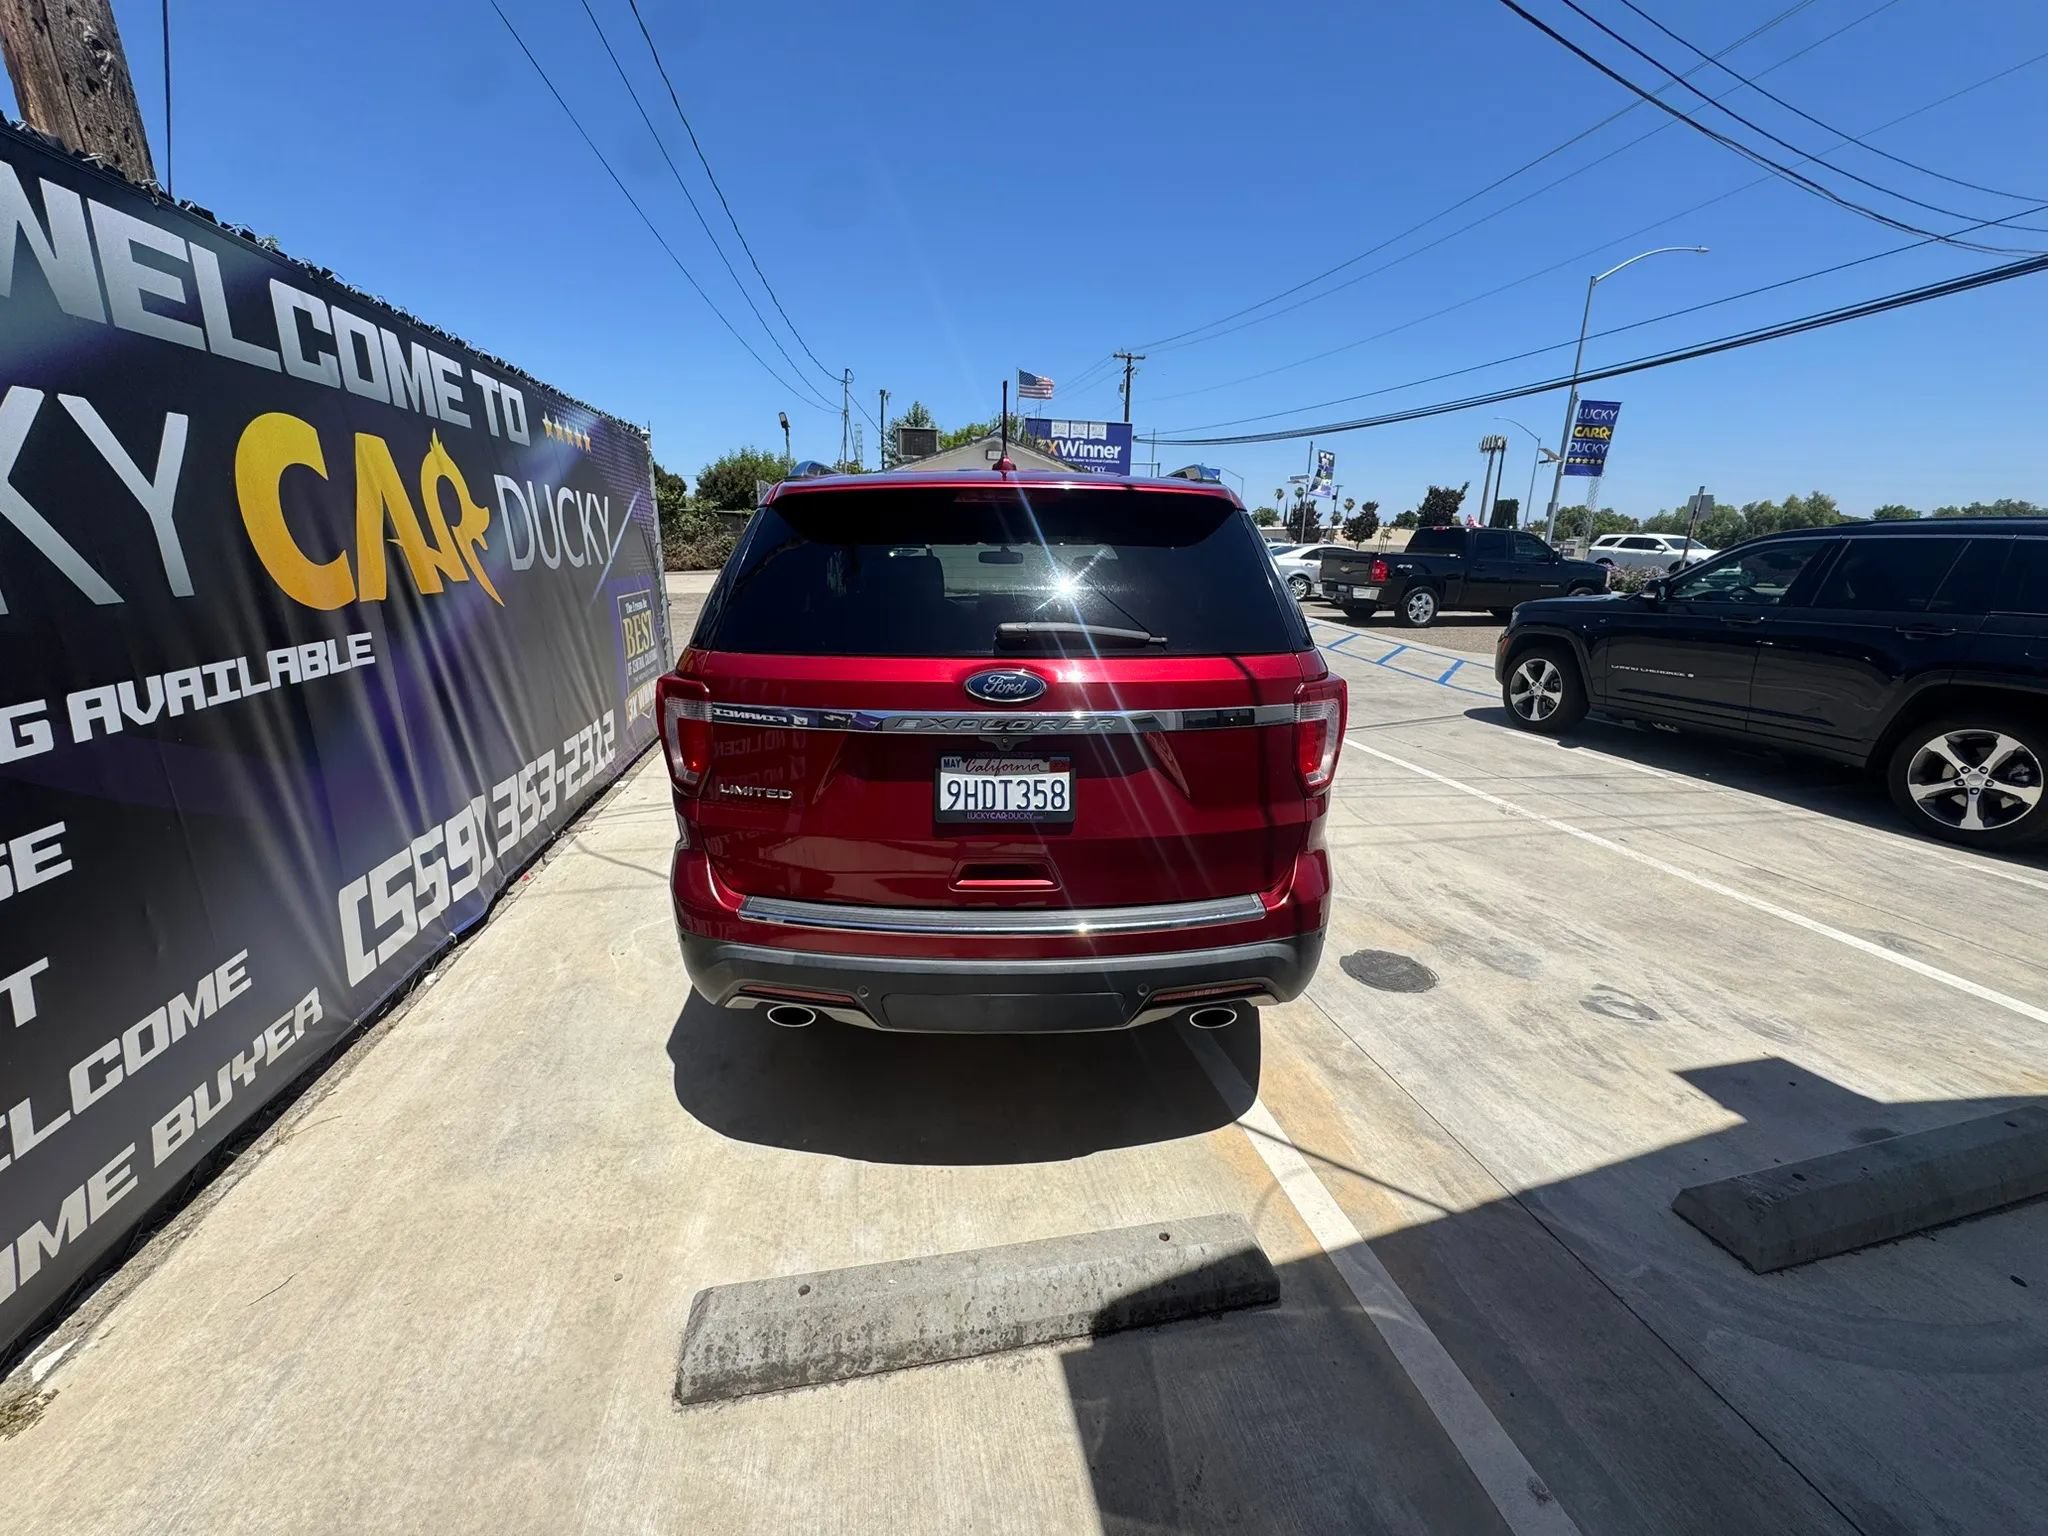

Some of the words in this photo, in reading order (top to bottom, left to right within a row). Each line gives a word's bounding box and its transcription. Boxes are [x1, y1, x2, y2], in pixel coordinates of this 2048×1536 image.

[471, 369, 530, 447] TO
[1578, 408, 1618, 420] LUCKY
[1569, 442, 1609, 454] DUCKY
[235, 412, 505, 611] CAR
[493, 474, 614, 571] DUCKY
[623, 610, 655, 659] BEST
[0, 699, 54, 764] G
[66, 632, 375, 743] AVAILABLE
[983, 674, 1027, 694] Ford
[894, 718, 1117, 731] EXPLORER
[720, 784, 793, 799] LIMITED
[943, 759, 961, 769] MAY
[965, 758, 1042, 776] California
[947, 780, 1066, 810] 9HDT358
[338, 795, 494, 987] (559)
[492, 709, 615, 858] 353-2312
[0, 957, 49, 1028] T
[0, 948, 252, 1173] LCOME
[151, 987, 323, 1168] BUYER
